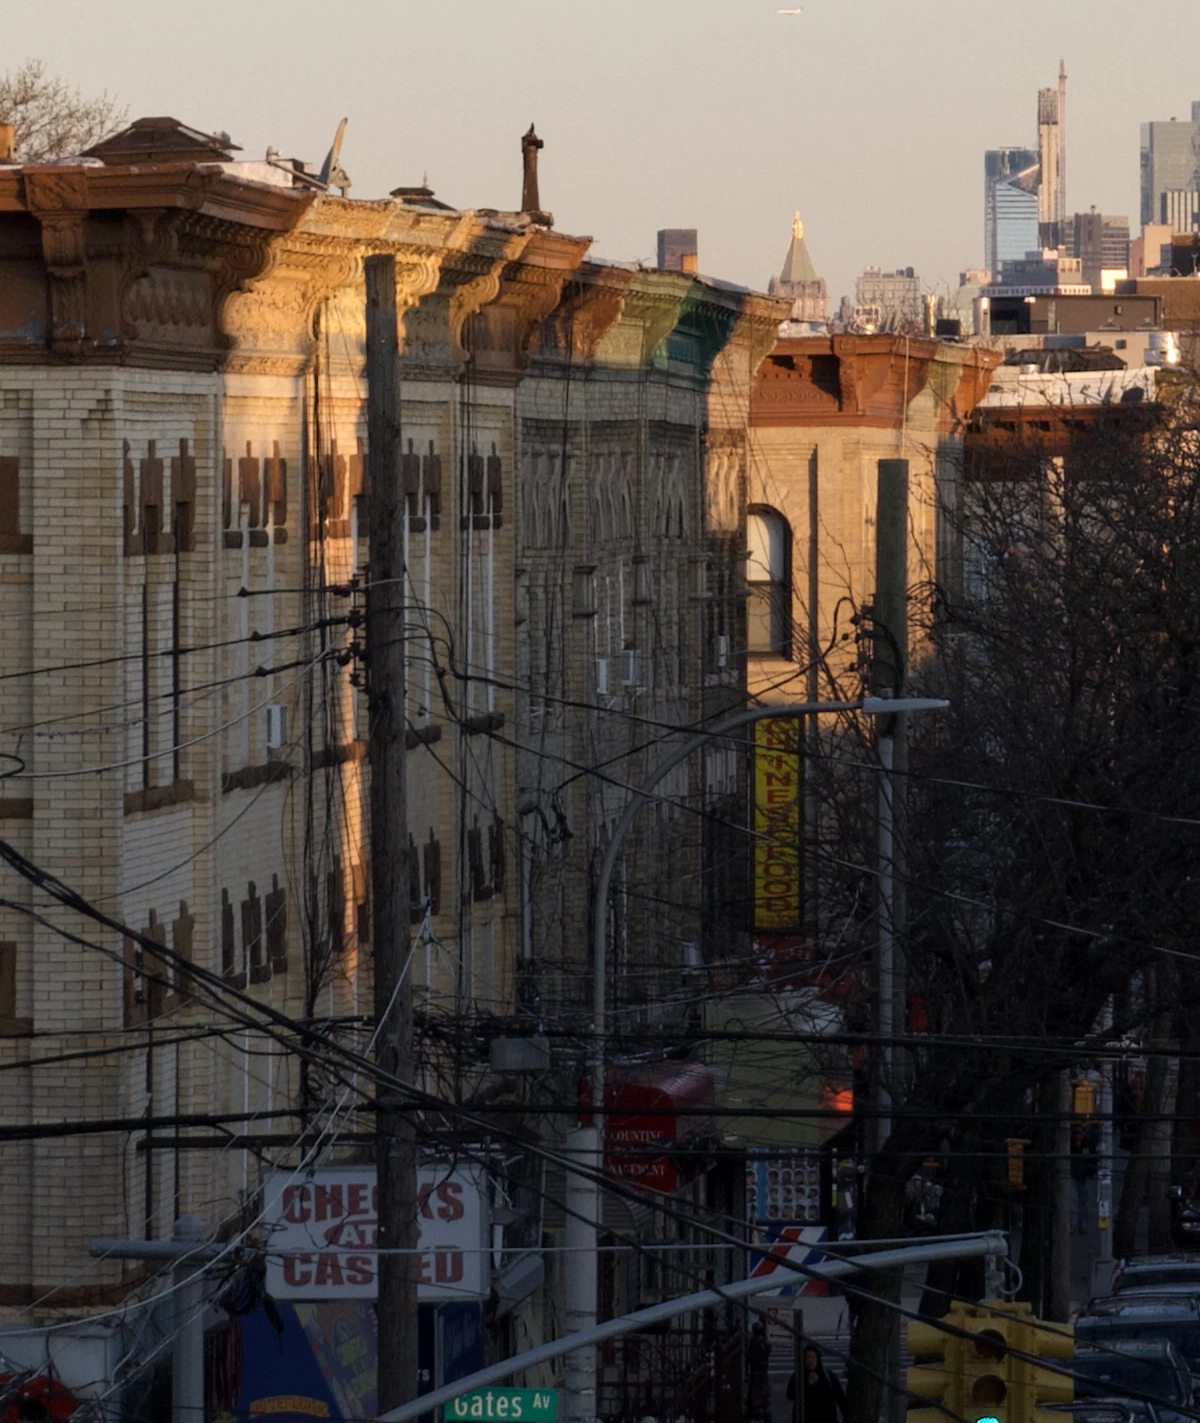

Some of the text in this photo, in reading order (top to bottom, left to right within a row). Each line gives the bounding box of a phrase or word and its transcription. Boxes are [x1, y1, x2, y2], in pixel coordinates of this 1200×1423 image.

[763, 844, 792, 912] FOOD
[283, 1182, 464, 1224] CHEKS
[284, 1246, 463, 1286] CASED
[454, 1391, 551, 1417] Gates Av
